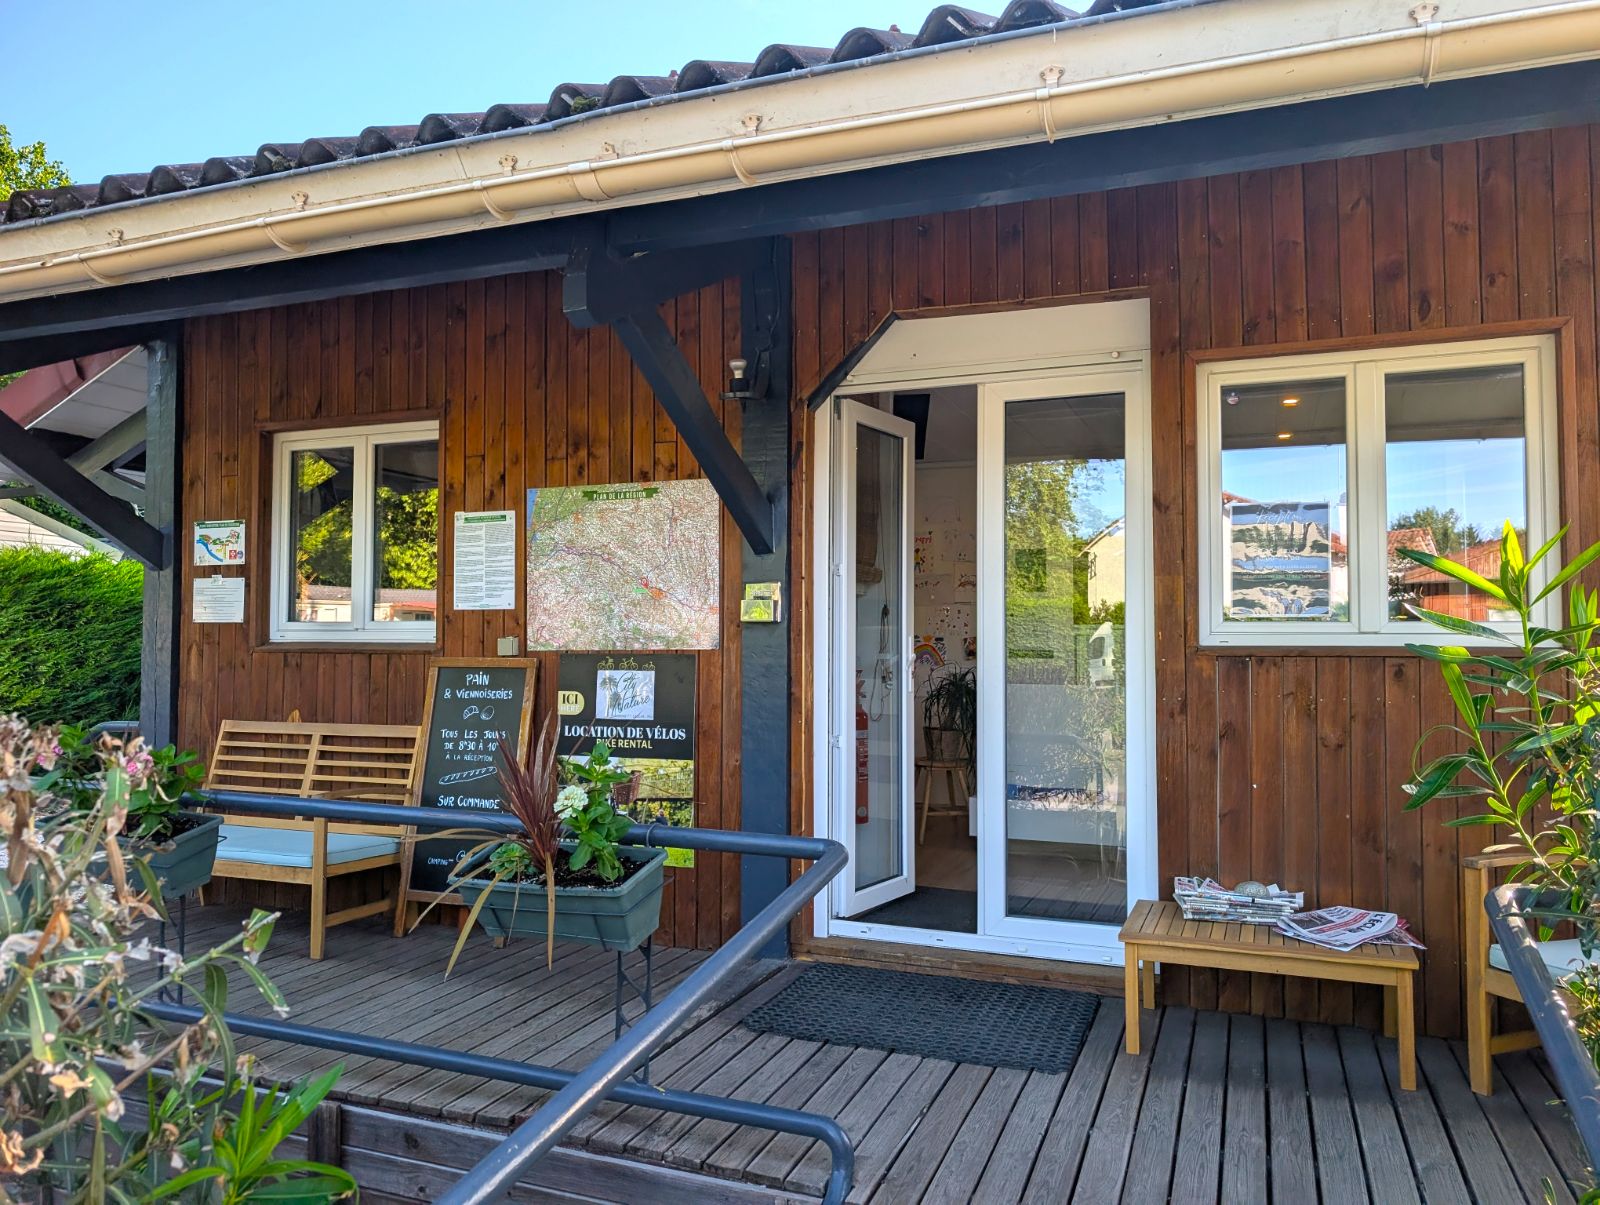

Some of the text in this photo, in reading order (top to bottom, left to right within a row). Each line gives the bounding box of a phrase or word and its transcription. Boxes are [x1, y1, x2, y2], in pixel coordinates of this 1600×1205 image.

[593, 493, 607, 501] PLAN
[608, 492, 616, 500] DE
[617, 491, 625, 499] LA
[443, 688, 452, 699] &
[562, 693, 579, 705] ICI
[464, 729, 478, 739] LES
[483, 730, 506, 740] JOUS
[564, 725, 687, 741] LOCATION DE VÉLOS
[443, 742, 454, 750] DE
[617, 739, 653, 749] RENTAL
[453, 752, 461, 760] LA
[464, 752, 493, 762] RÉCEPTION
[437, 795, 455, 807] SUR
